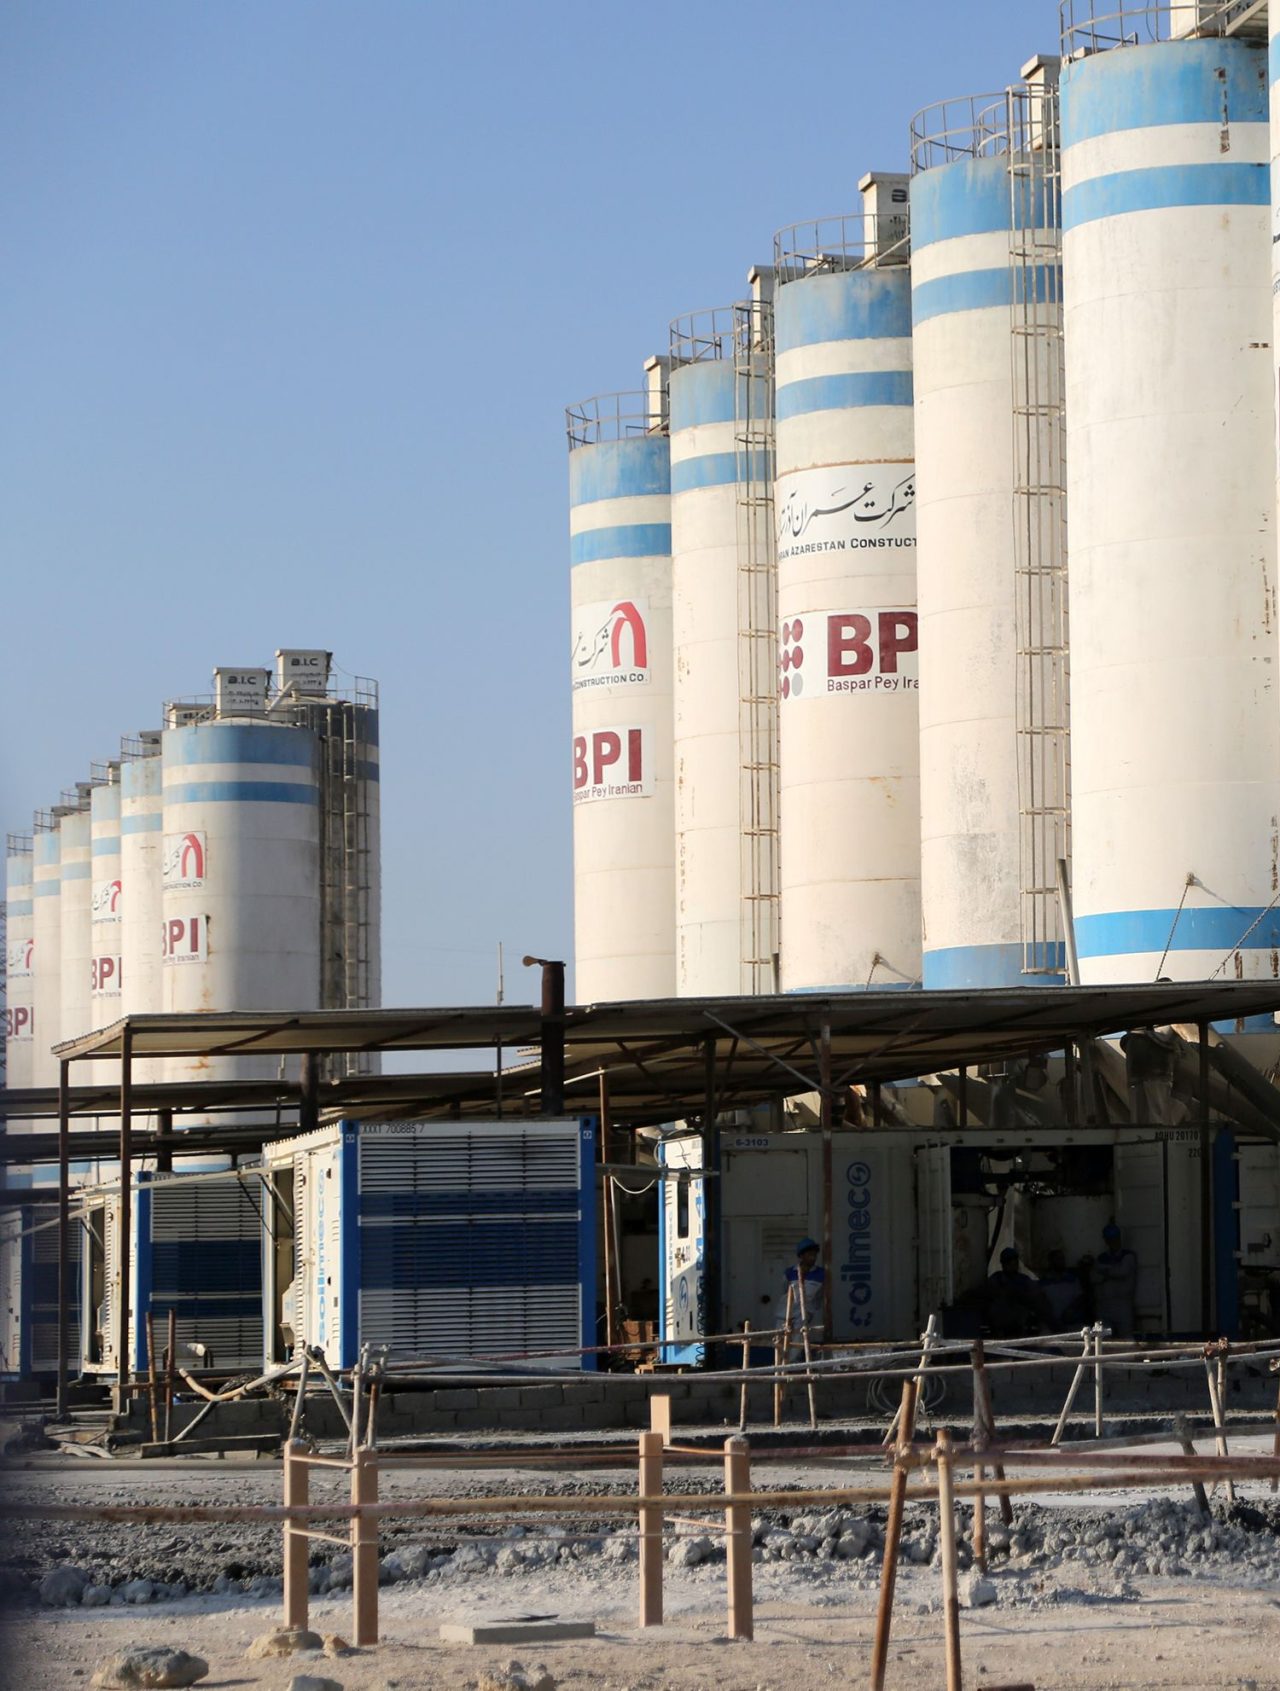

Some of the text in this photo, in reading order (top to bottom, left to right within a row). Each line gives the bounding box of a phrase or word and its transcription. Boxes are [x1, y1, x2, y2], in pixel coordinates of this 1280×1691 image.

[790, 540, 846, 556] AZARESTAN
[827, 679, 872, 693] Baspar
[875, 676, 899, 690] Pey
[574, 729, 642, 789] BPI
[608, 784, 643, 795] Iranian
